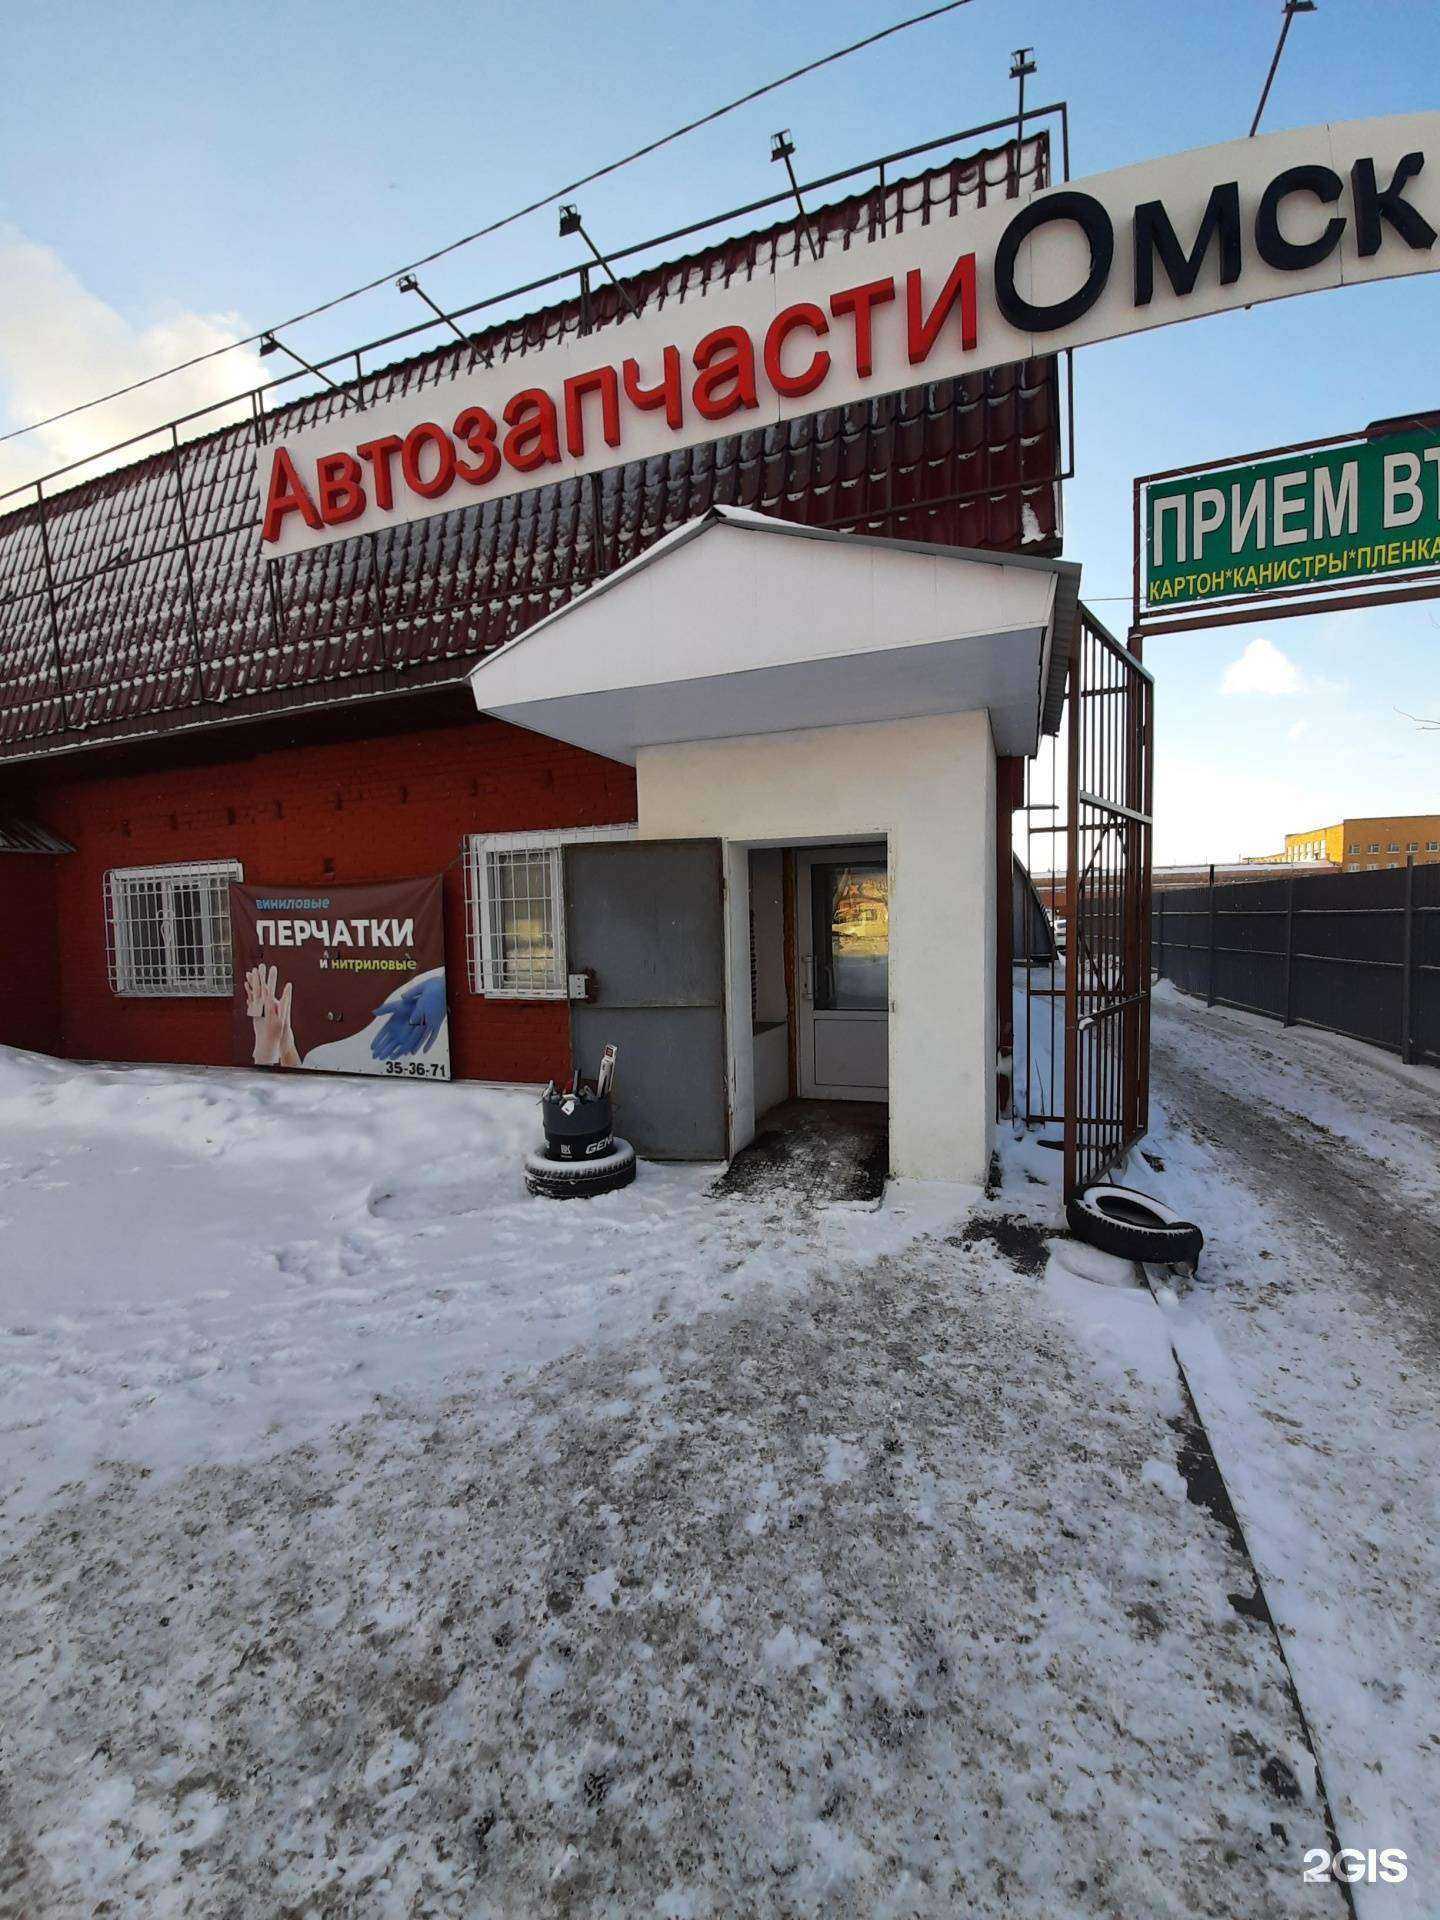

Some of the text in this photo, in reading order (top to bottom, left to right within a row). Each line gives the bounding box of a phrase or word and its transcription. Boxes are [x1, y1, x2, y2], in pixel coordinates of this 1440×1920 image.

[1153, 461, 1359, 567] ПРИЕМ
[256, 898, 330, 910] виниловые
[256, 919, 414, 947] ПЕРЧАТКИ
[331, 957, 418, 973] нитриловые
[386, 1061, 446, 1078] 35-36-71
